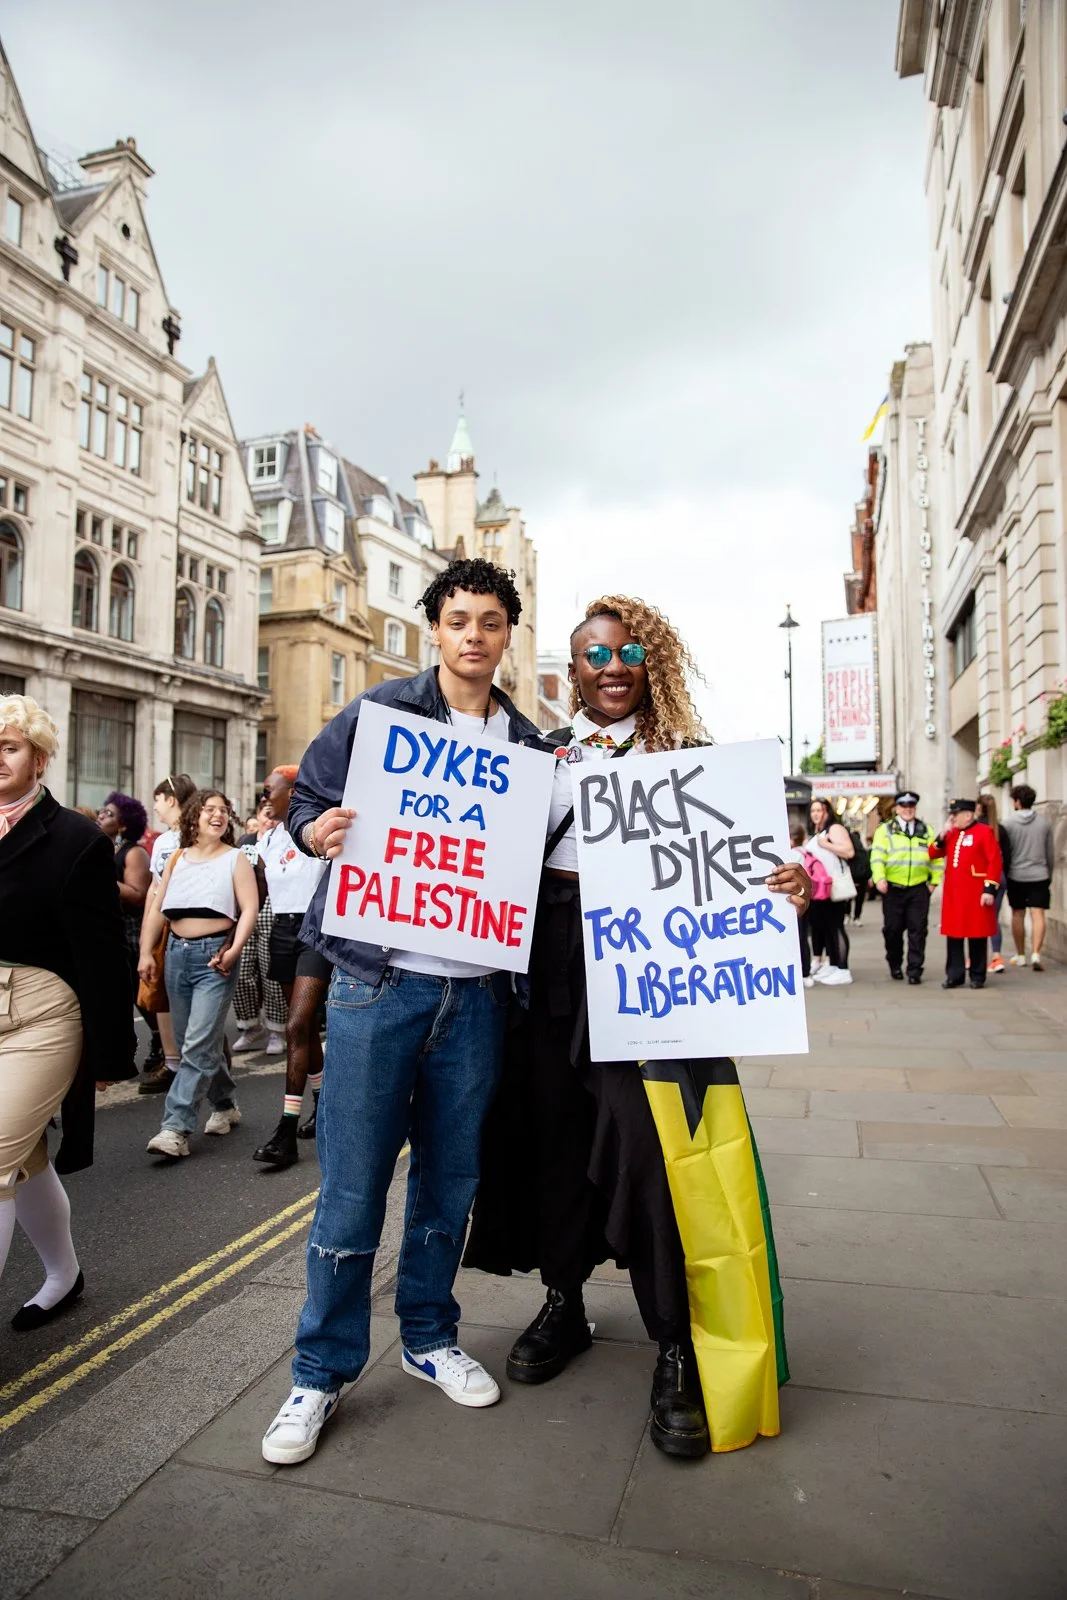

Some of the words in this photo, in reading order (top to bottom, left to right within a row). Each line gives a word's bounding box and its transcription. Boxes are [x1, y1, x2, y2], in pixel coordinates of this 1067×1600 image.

[913, 418, 932, 587] Trafalgar
[827, 668, 869, 690] PEOPLE
[920, 598, 937, 741] Theatre
[384, 725, 510, 795] DYKES
[399, 789, 452, 824] FOR
[460, 803, 486, 831] A
[580, 764, 735, 845] BLACK
[384, 828, 486, 880] FREE
[650, 831, 786, 907] DYKES
[336, 864, 528, 948] PALESTINE
[584, 906, 652, 960] FOR
[664, 899, 786, 960] QUEER
[616, 957, 798, 1019] LIBERATION
